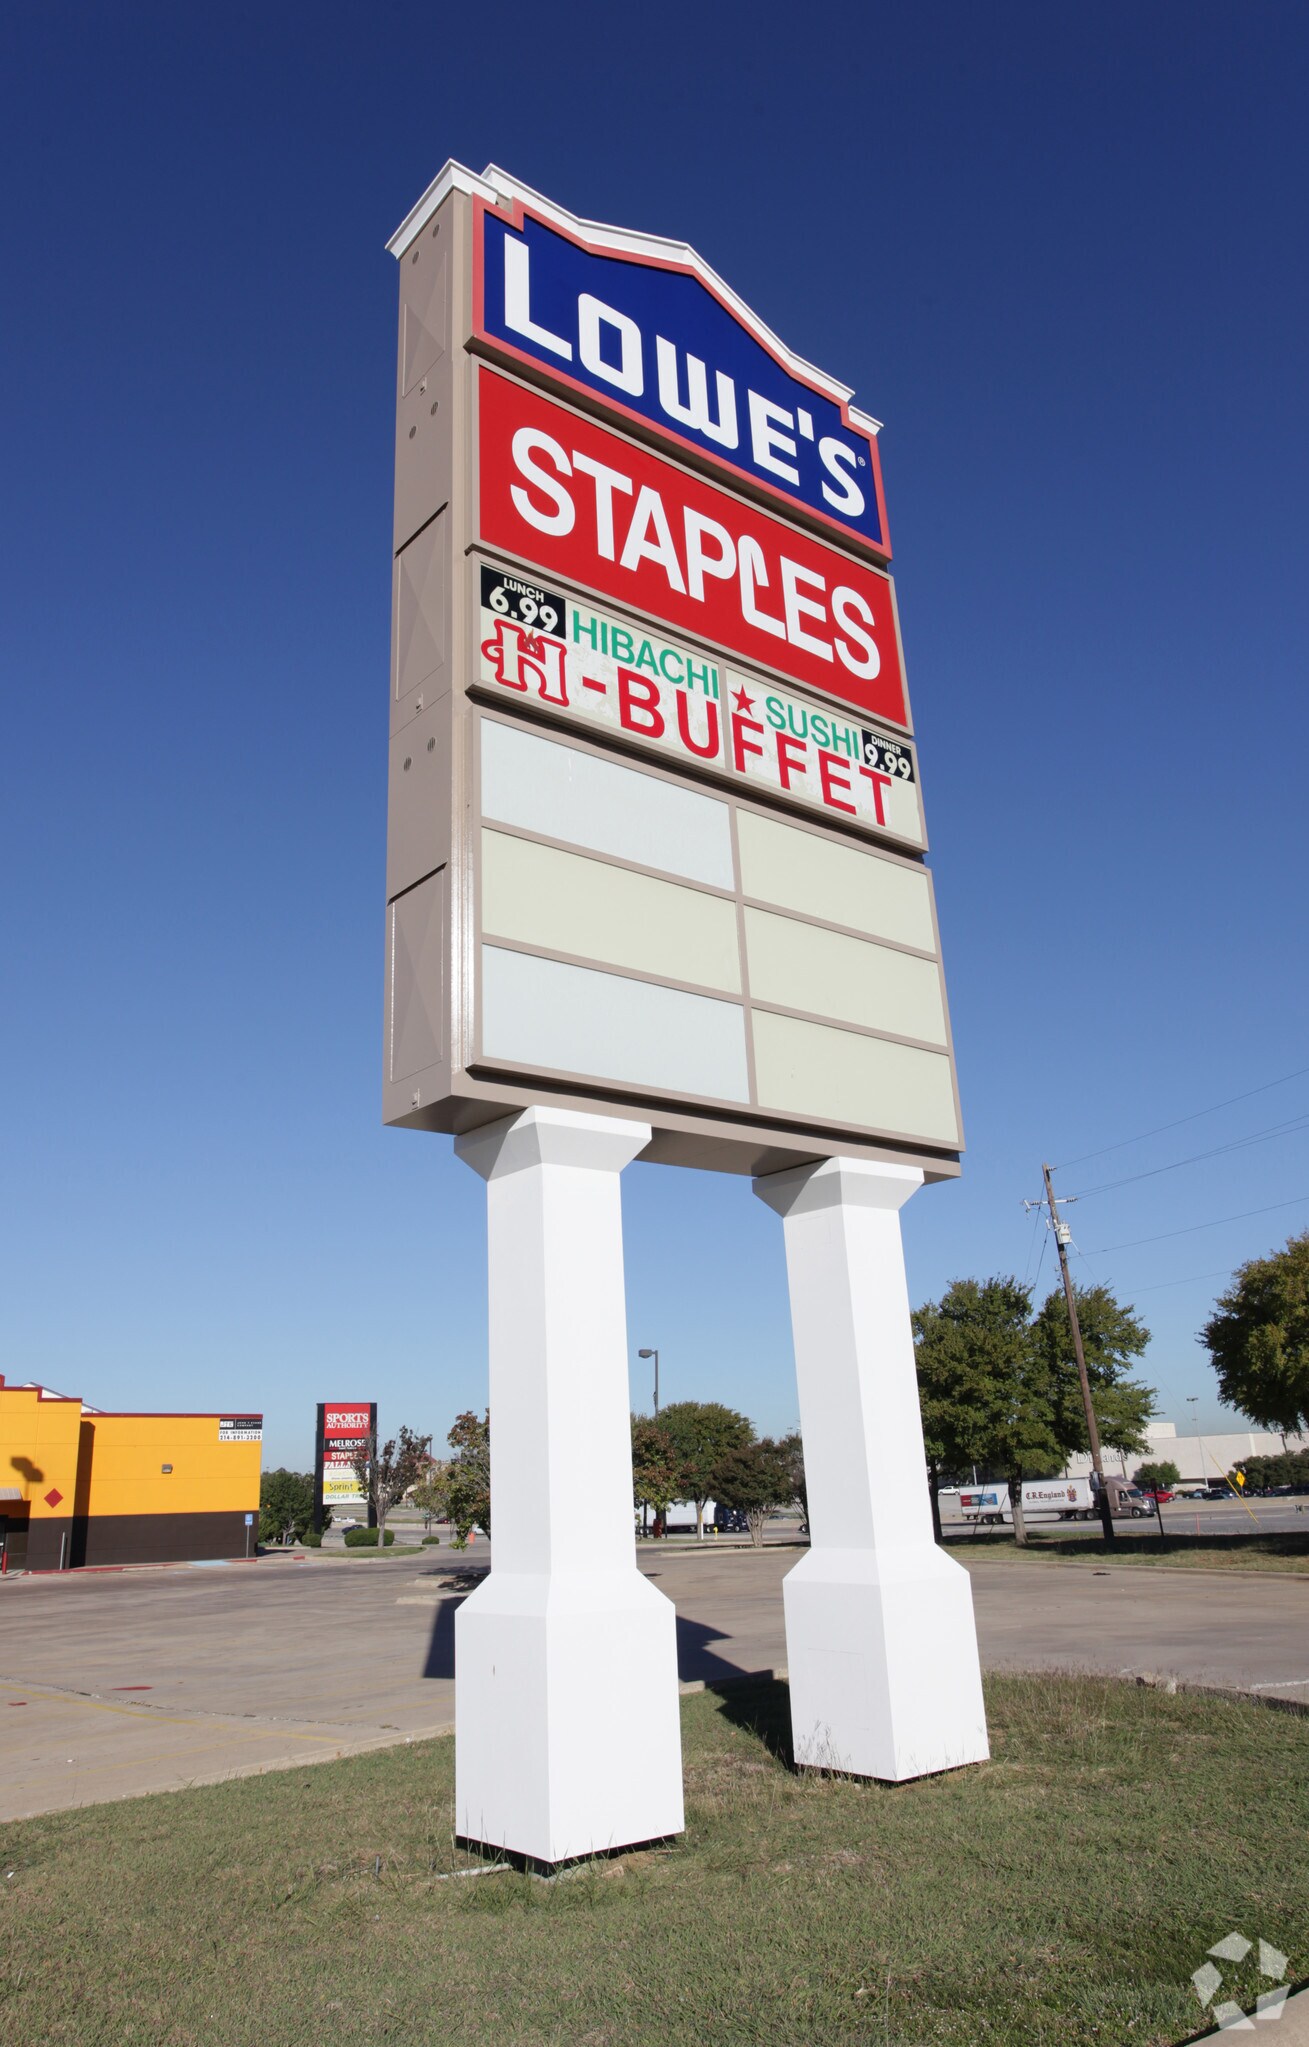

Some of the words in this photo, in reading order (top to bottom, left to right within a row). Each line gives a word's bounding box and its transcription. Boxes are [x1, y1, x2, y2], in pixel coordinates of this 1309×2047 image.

[504, 233, 866, 518] LOWE'S
[510, 427, 881, 681] STAPLES
[503, 577, 545, 603] LUNCH
[489, 586, 558, 632] 6.99
[573, 610, 719, 699] HIBACHI
[765, 696, 860, 760] SUSHI
[871, 735, 902, 755] DINNER
[865, 743, 911, 780] 9.99
[326, 1413, 369, 1423] SPORTS
[329, 1439, 366, 1448] MELROSE
[331, 1451, 362, 1460] STAPLE
[329, 1483, 353, 1492] Sprint
